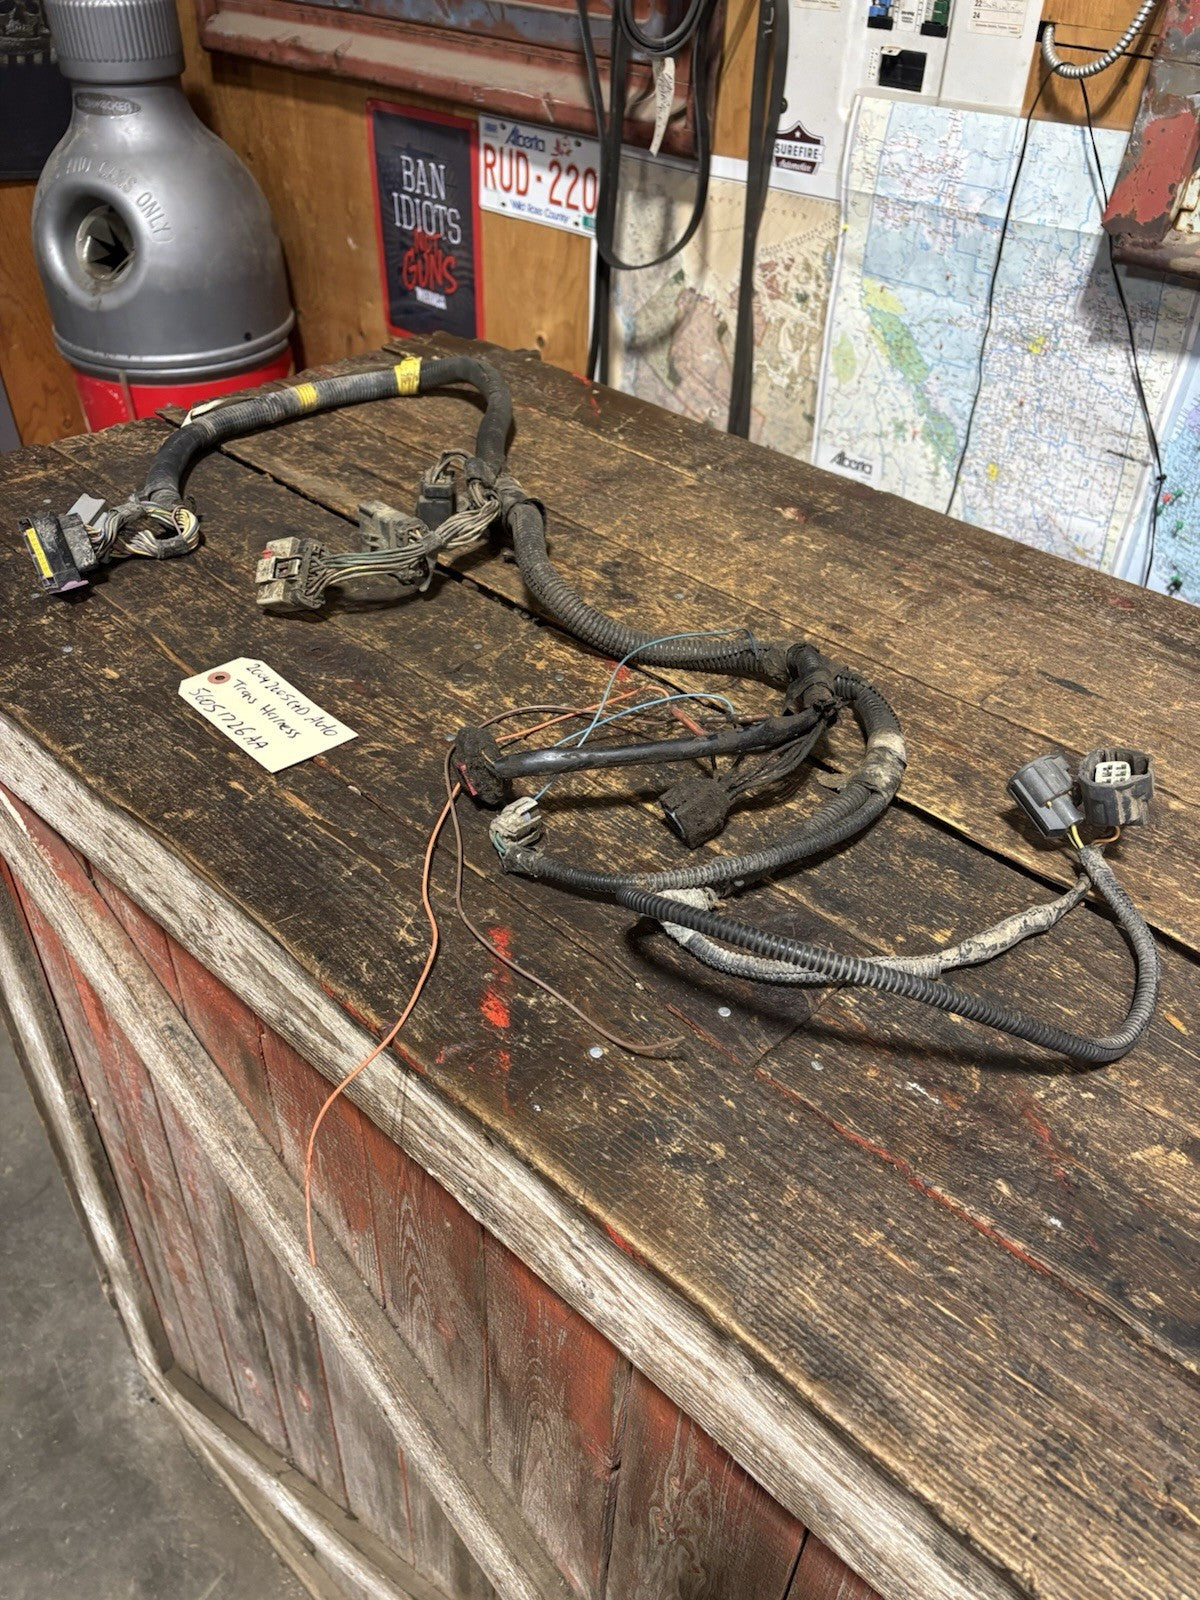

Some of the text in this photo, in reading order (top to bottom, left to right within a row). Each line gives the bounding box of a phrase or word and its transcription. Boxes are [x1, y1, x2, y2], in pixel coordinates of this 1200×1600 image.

[504, 125, 546, 153] Alberta
[774, 143, 819, 160] SUREFIRE
[401, 155, 447, 200] BAN
[391, 192, 462, 245] IDIOTS
[402, 247, 458, 295] GUNS
[233, 678, 258, 704] Trans
[303, 716, 338, 736] Auto
